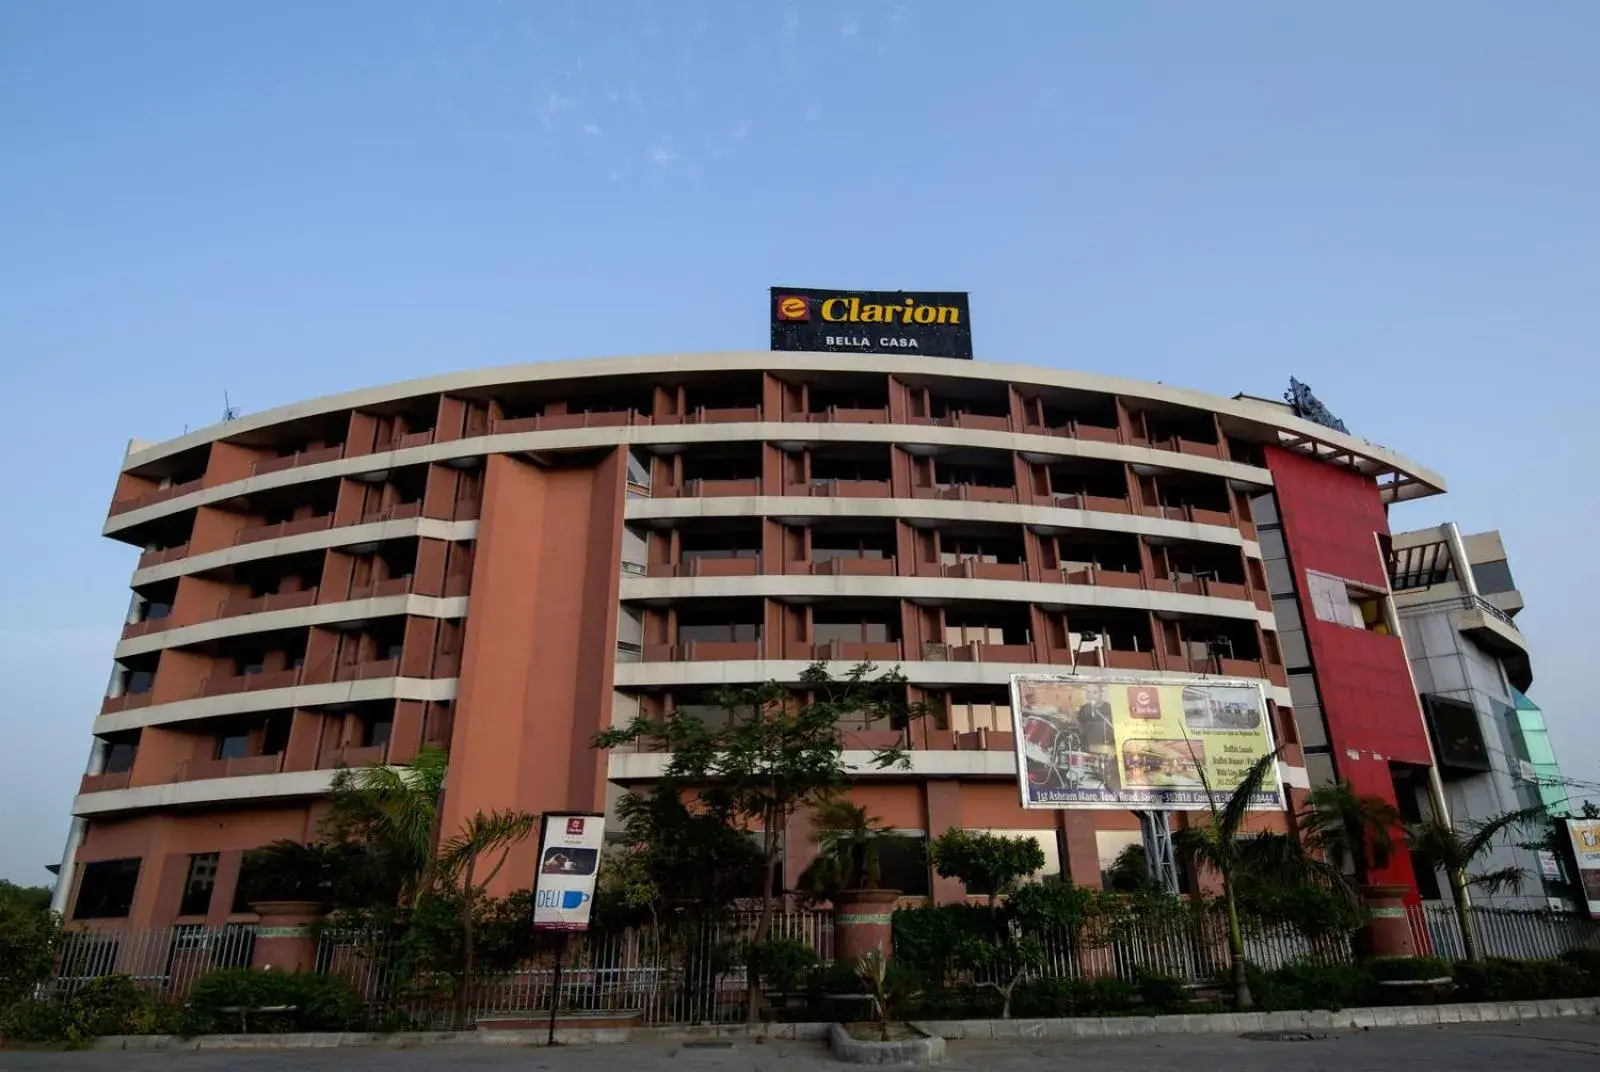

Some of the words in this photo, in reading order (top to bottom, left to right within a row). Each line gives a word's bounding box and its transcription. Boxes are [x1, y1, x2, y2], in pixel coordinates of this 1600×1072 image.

[820, 297, 960, 324] Clarion
[826, 336, 870, 346] BELLA
[880, 337, 918, 348] CASA
[1049, 790, 1077, 801] Ashram
[537, 888, 560, 908] DELI
